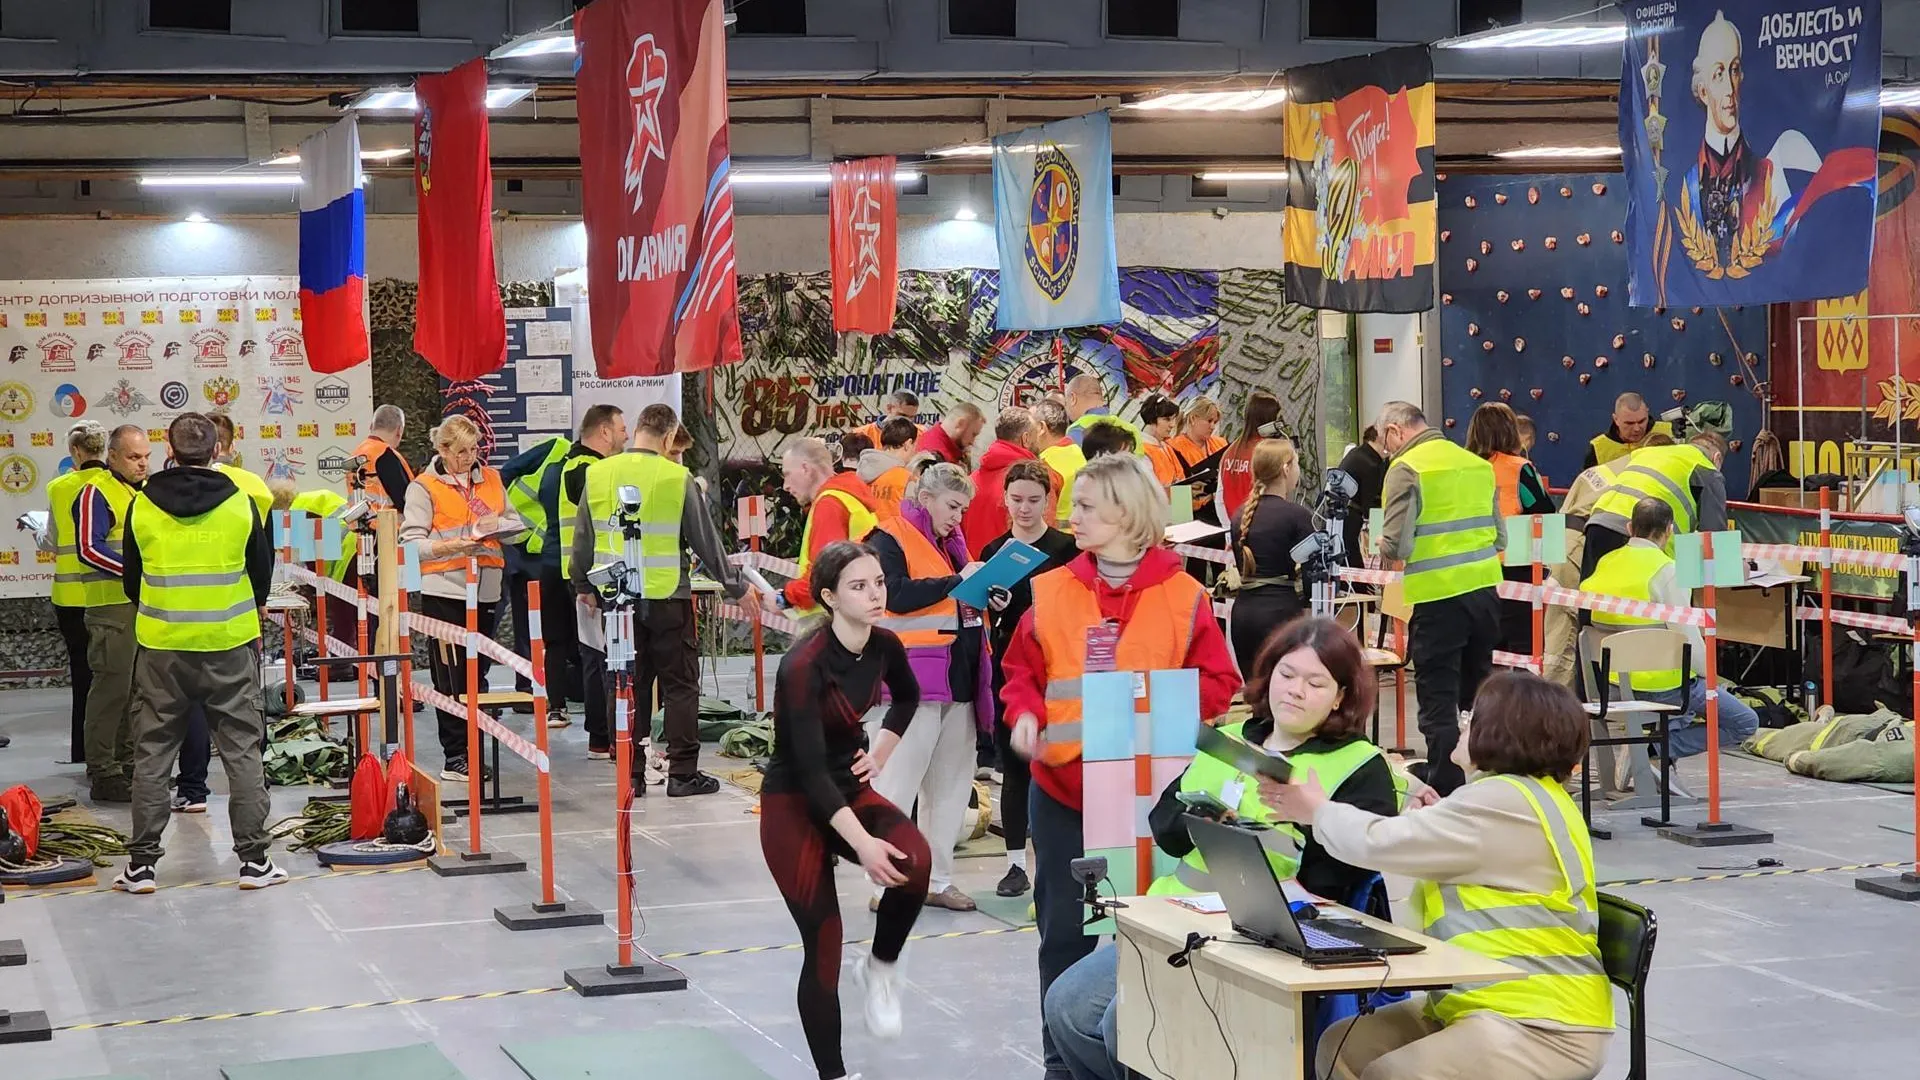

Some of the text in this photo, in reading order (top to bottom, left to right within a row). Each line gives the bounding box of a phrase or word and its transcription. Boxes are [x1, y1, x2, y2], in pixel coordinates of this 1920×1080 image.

[1636, 1, 1677, 19] ОФИЦЕРЫ
[1641, 17, 1675, 30] РОССИИ
[1758, 6, 1845, 48] ДОБЛЕСТЬ
[1775, 34, 1858, 70] ВЕРНОСТ
[38, 290, 154, 306] ДОПРИЗЫВНОЙ
[160, 291, 259, 303] ПОДГОТОВКИ
[636, 378, 666, 387] АРМИИ
